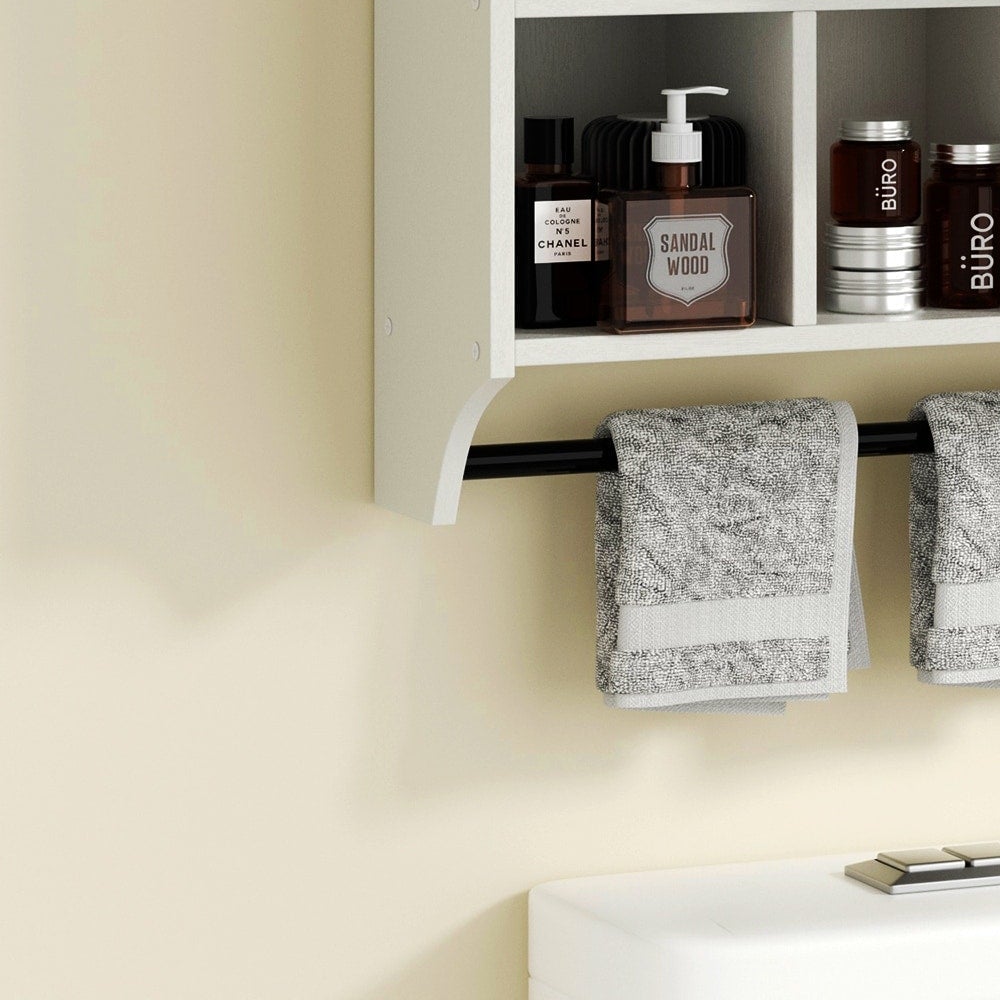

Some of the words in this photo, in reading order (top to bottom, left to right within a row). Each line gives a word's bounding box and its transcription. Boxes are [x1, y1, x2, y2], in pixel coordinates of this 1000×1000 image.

[875, 158, 897, 211] BÜRO
[537, 239, 588, 249] CHANEL
[661, 232, 716, 253] SANDAL
[960, 212, 994, 290] BÜRO
[667, 255, 709, 276] WOOD
